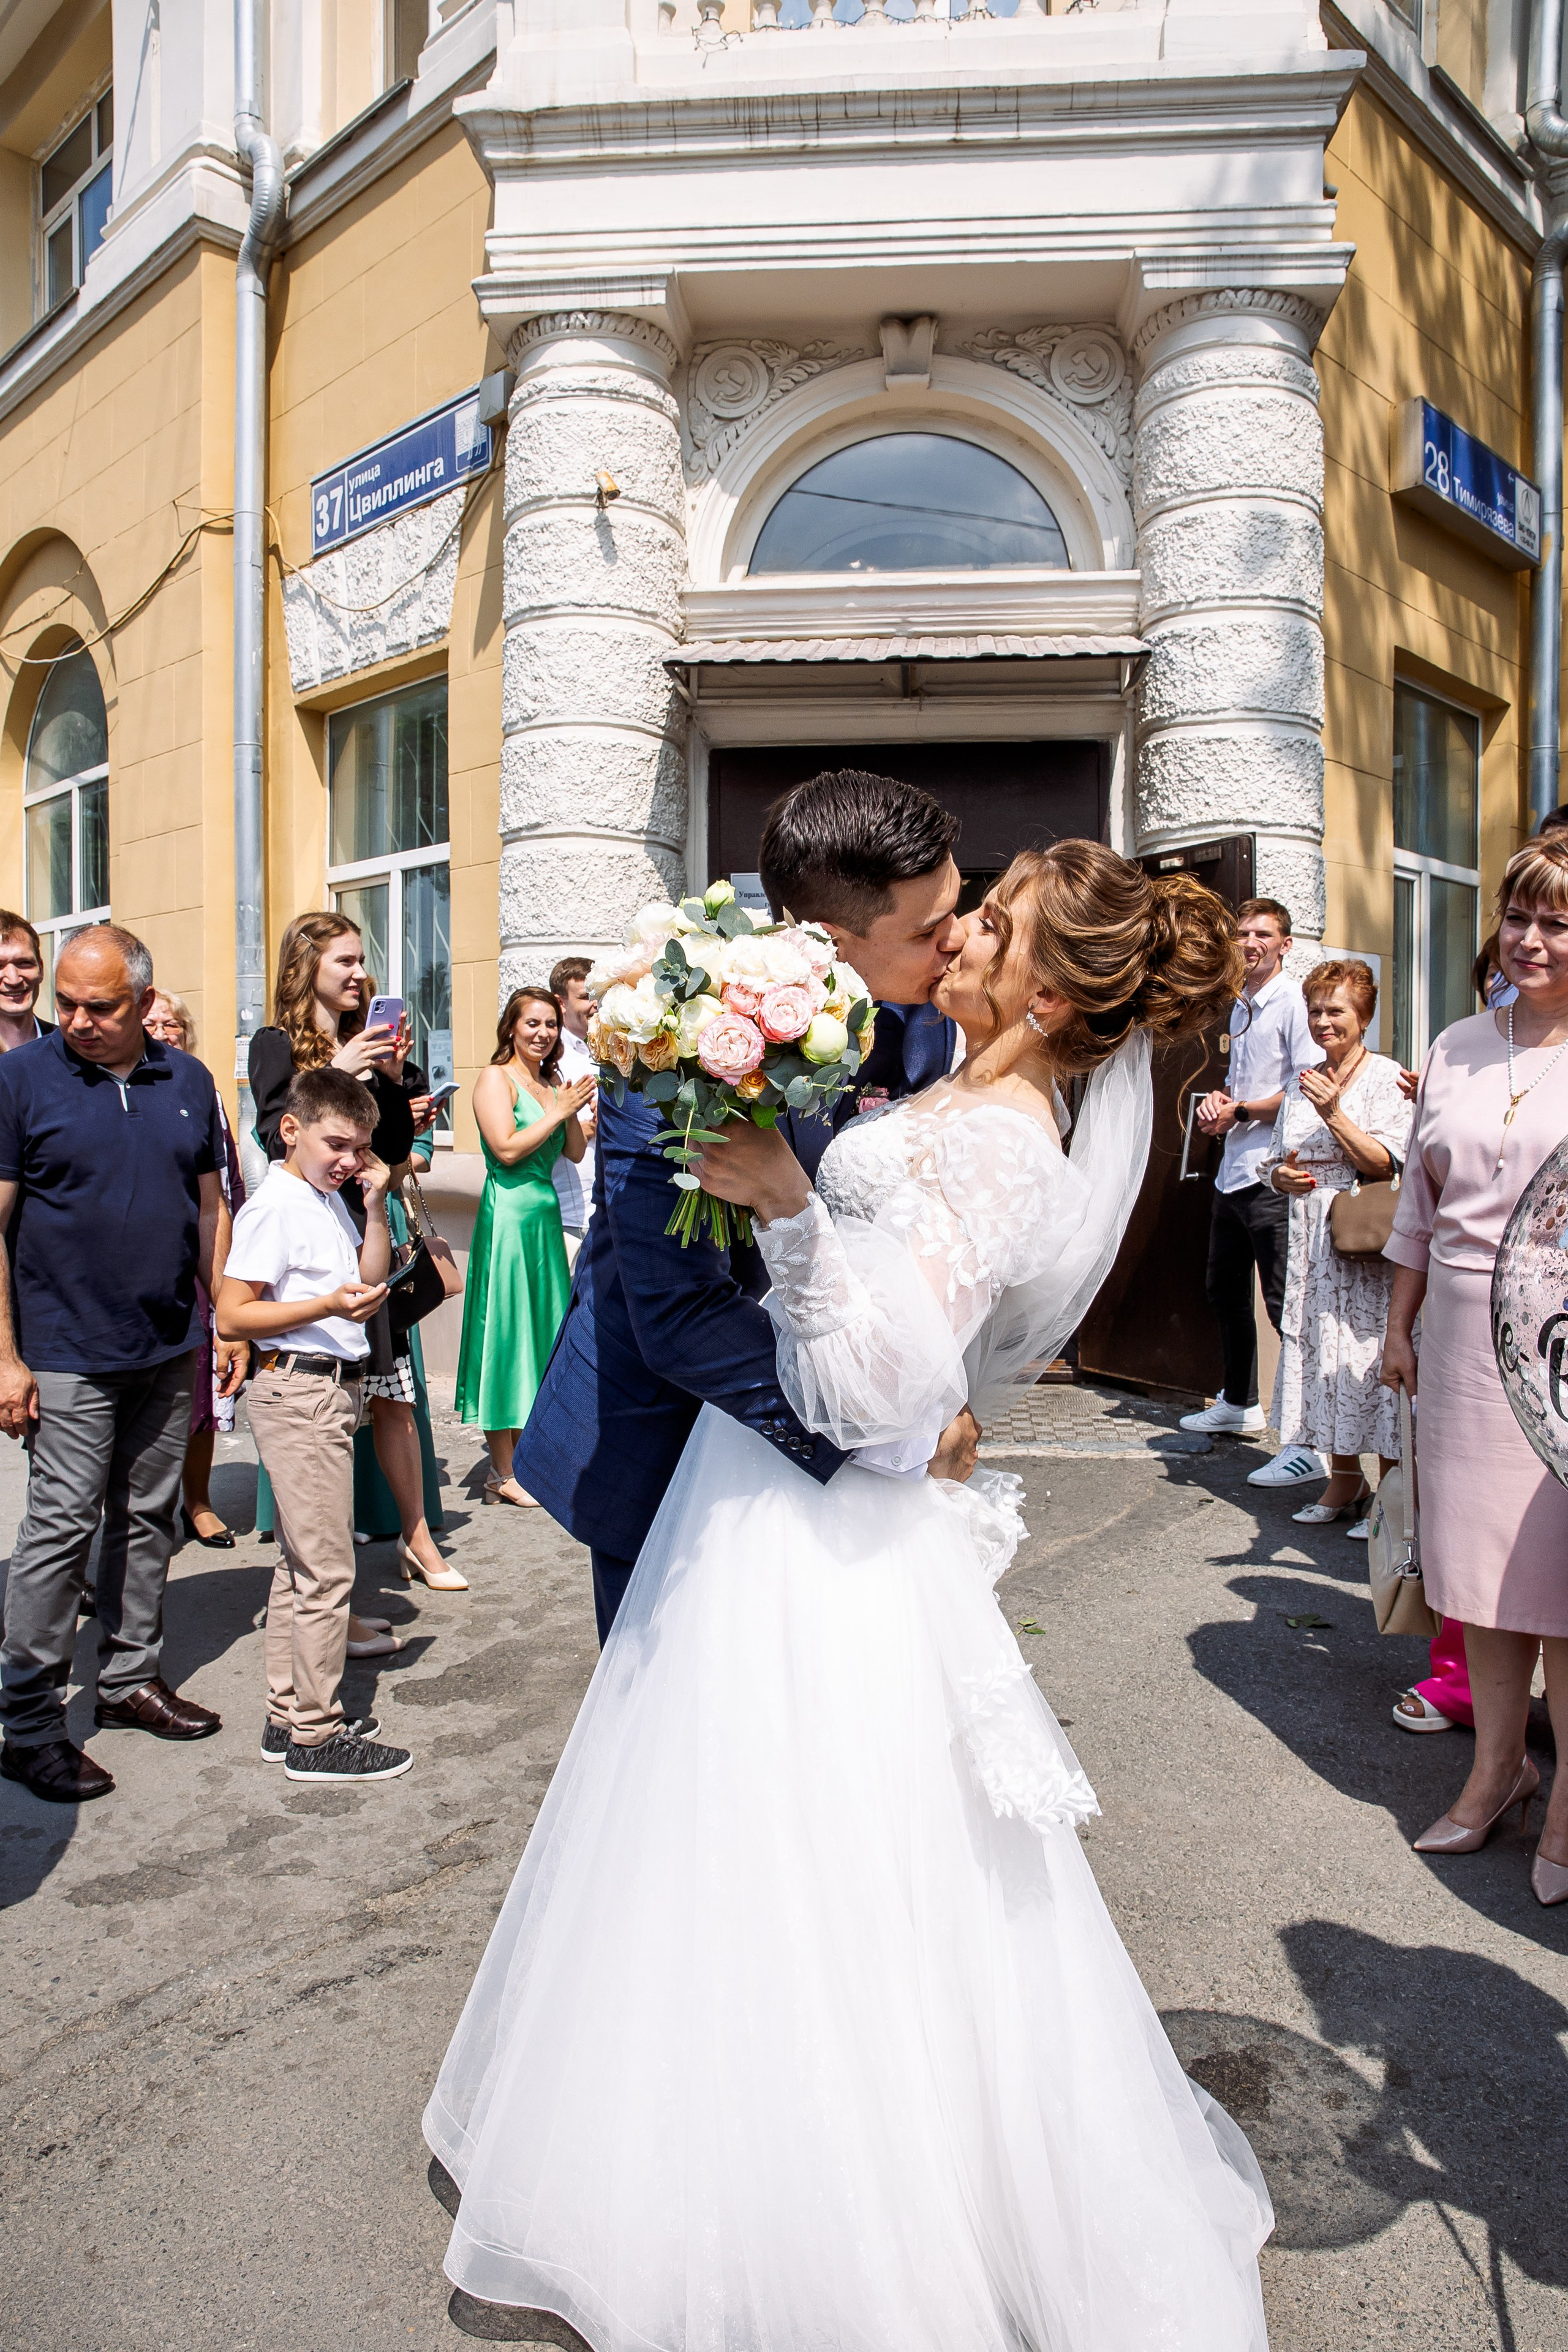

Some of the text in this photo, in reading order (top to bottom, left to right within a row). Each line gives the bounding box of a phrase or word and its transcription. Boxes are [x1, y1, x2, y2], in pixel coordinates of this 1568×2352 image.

[349, 464, 381, 495] улица
[349, 456, 445, 523] Цвиллинга
[1425, 441, 1450, 494] 28
[315, 485, 343, 538] 37
[1453, 476, 1515, 538] Тимирязева
